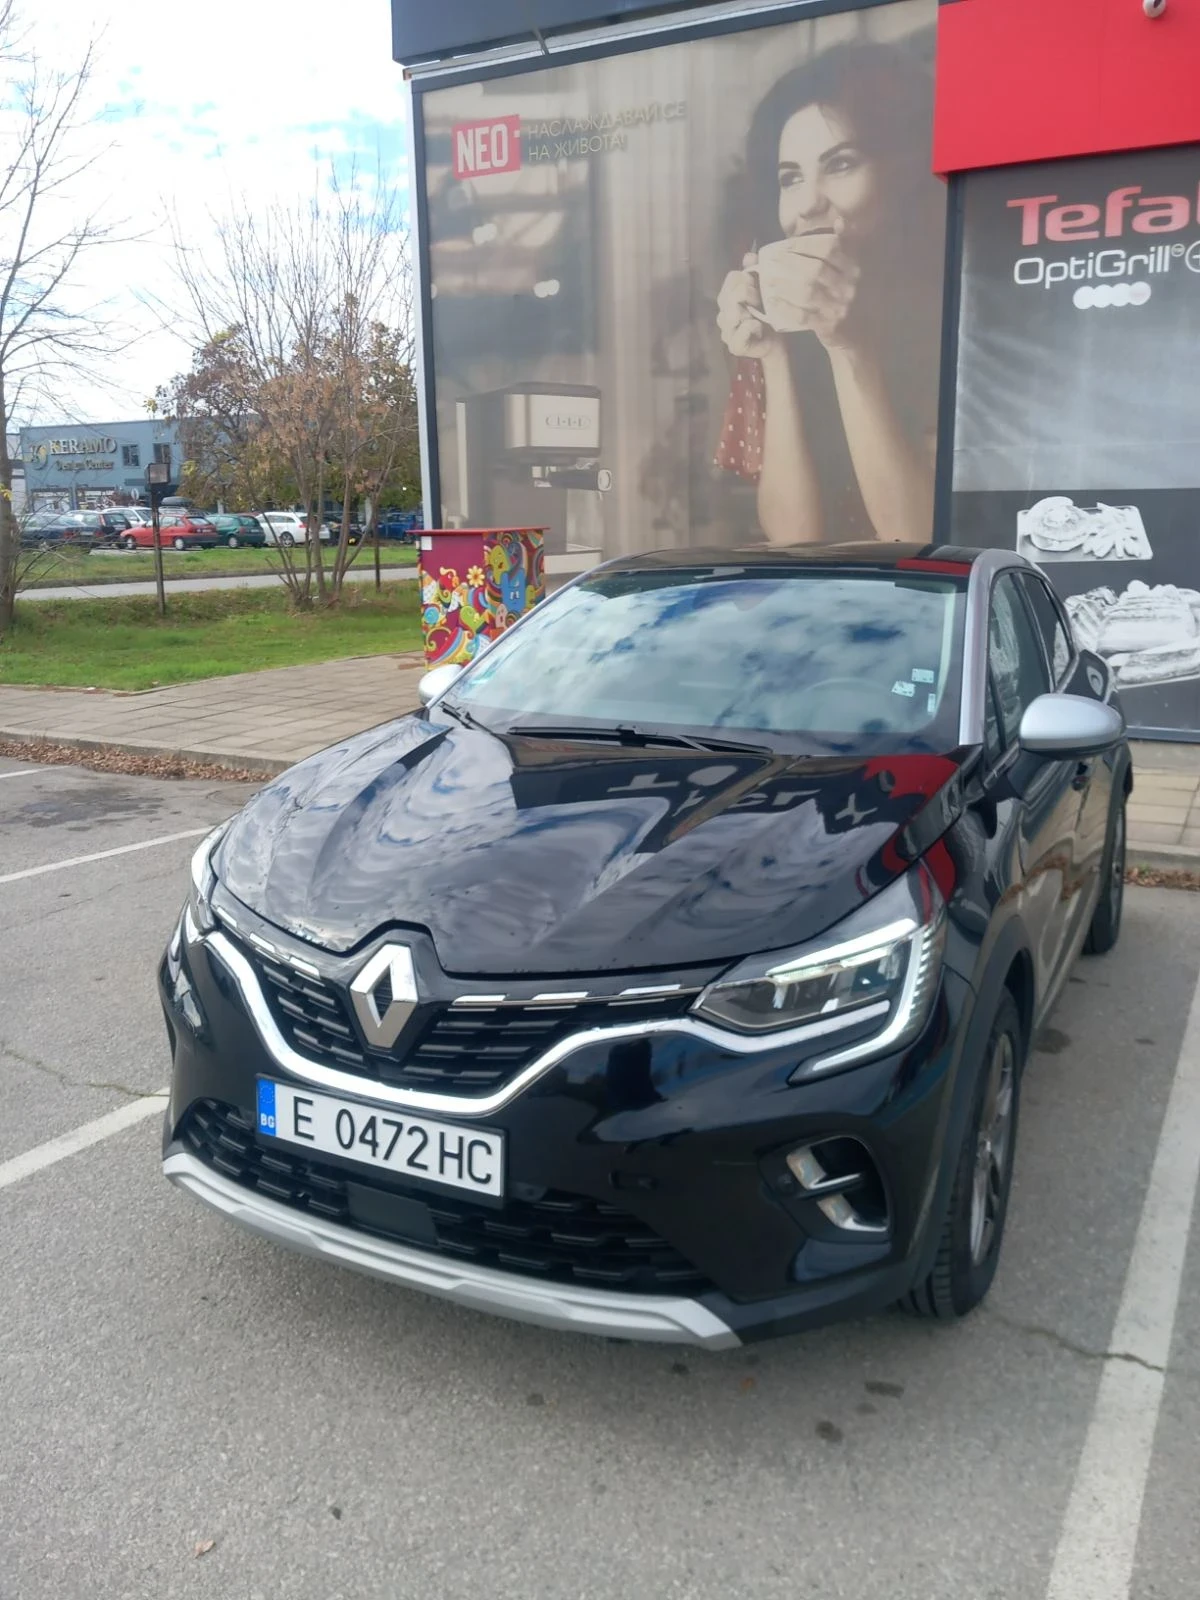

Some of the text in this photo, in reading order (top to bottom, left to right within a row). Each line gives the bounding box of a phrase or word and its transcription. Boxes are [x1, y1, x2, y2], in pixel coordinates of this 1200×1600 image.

[527, 101, 686, 139] НАСЛАЖДАВАЙ СЕ
[456, 122, 508, 173] NEO
[528, 144, 550, 161] НА
[1006, 181, 1200, 246] Tefa
[1014, 245, 1170, 289] OptiGrill
[49, 438, 118, 455] KERAMO
[260, 1113, 275, 1129] BG
[293, 1096, 315, 1141] E
